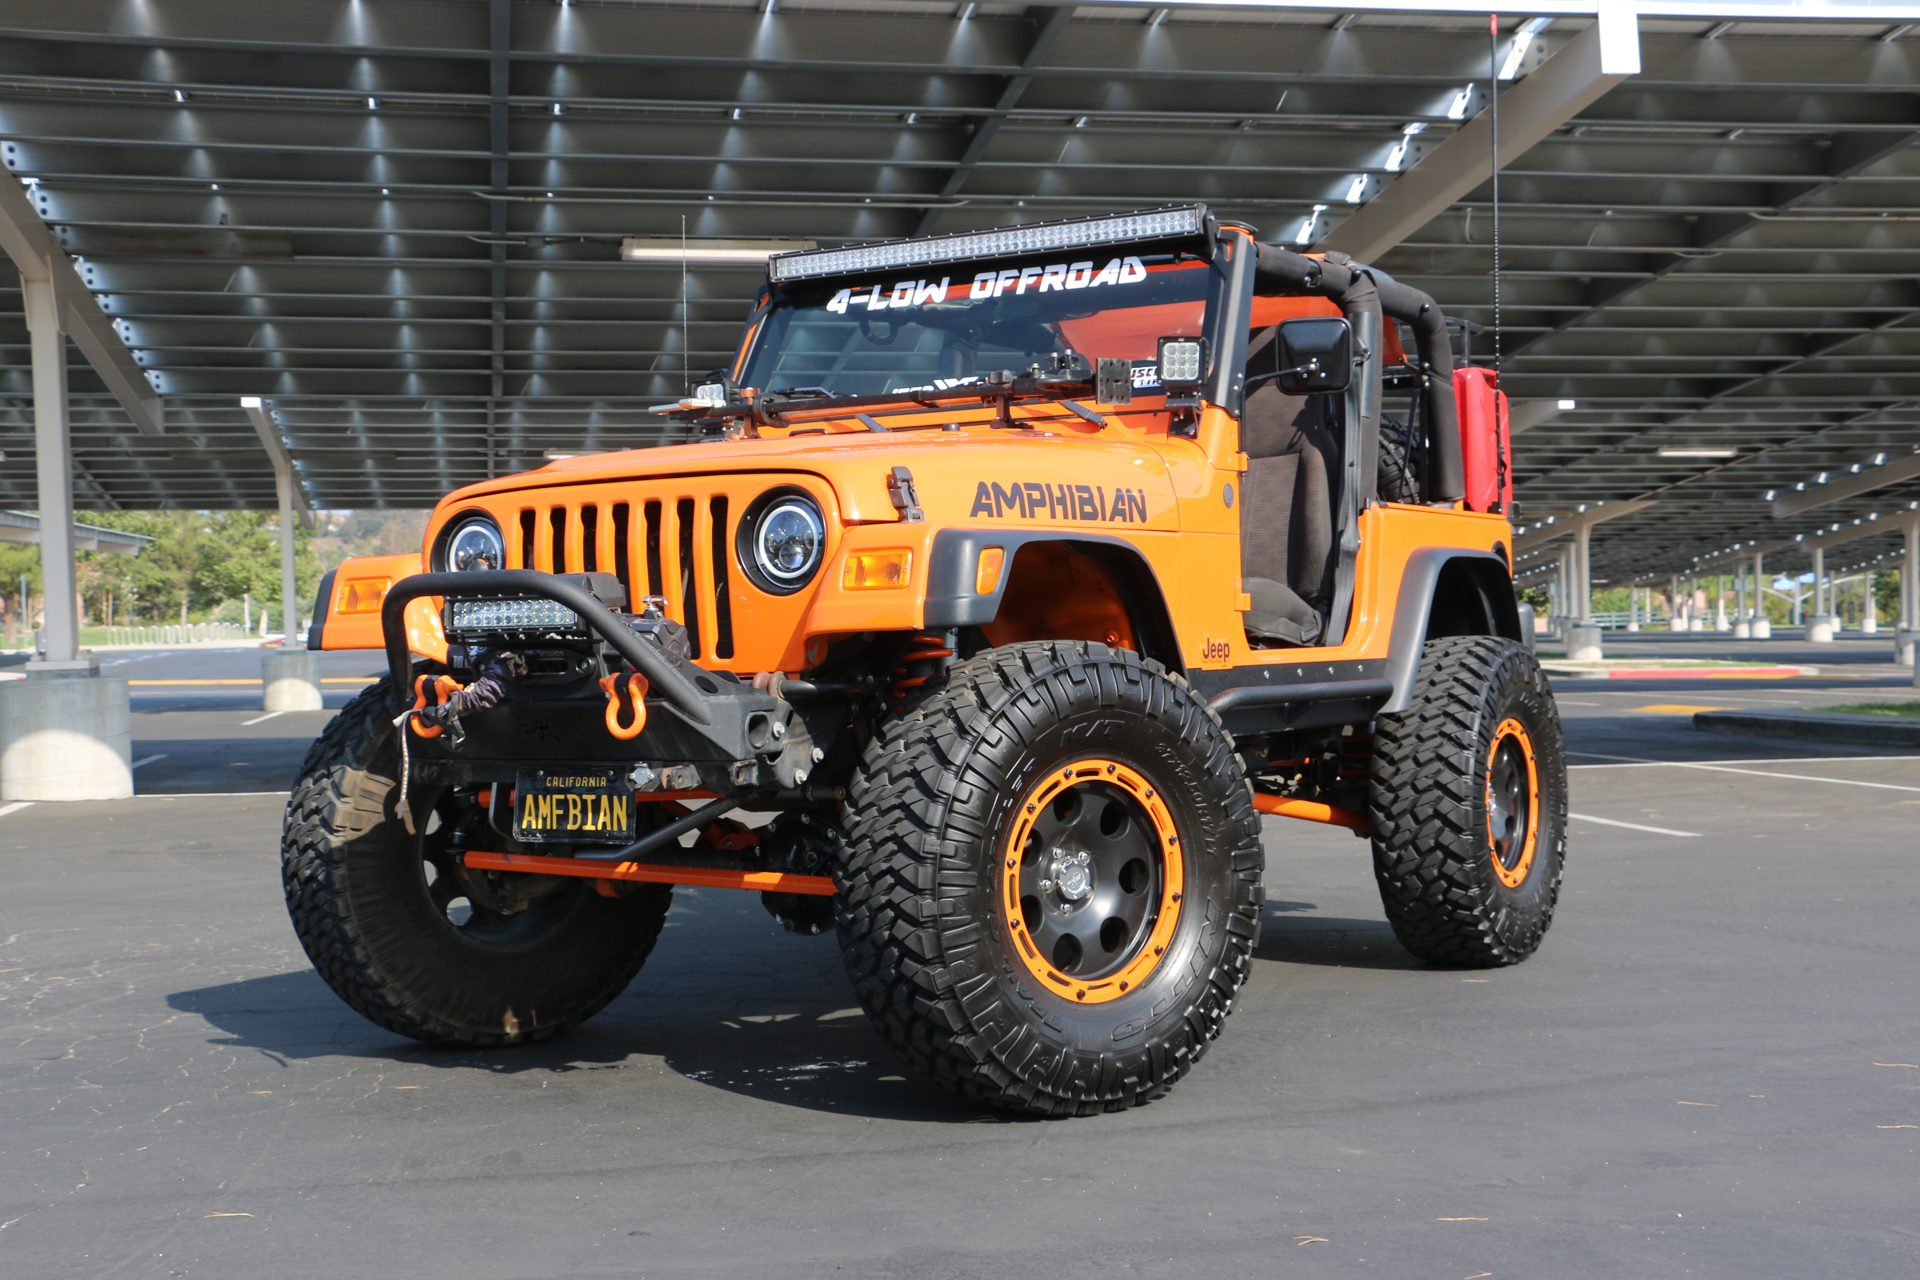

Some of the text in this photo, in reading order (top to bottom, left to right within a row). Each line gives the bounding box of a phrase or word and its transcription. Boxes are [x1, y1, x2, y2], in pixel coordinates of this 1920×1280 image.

[826, 256, 1147, 314] 4-LOW OFFROAD
[969, 481, 1148, 524] AMPHIBIAN
[1202, 637, 1230, 663] Jeep
[546, 776, 607, 788] CALIFORNIA
[521, 793, 628, 832] AMFBIAN
